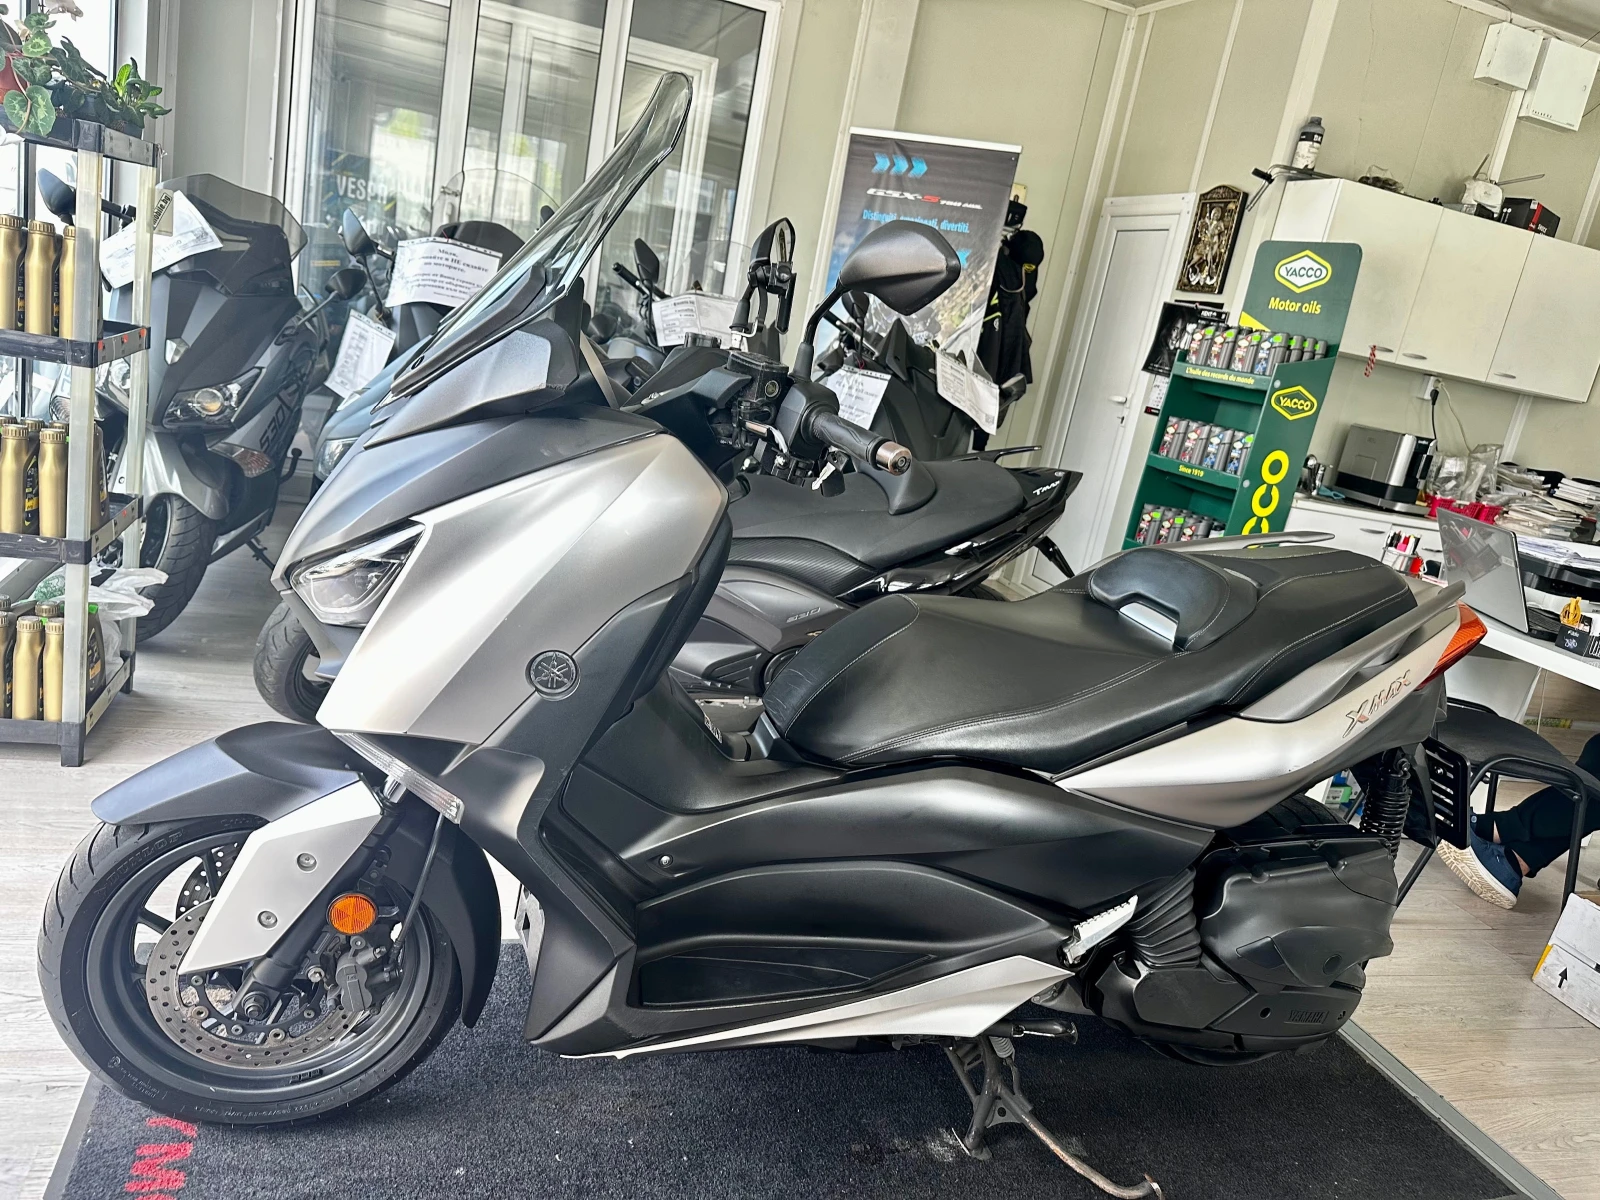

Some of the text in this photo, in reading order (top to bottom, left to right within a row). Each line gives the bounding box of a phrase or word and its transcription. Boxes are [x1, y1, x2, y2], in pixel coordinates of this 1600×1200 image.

[866, 188, 940, 203] GSX-S
[1284, 266, 1323, 279] YACCO
[1268, 297, 1322, 315] Motor oils
[1201, 369, 1211, 378] des
[1210, 372, 1229, 381] records
[1228, 373, 1236, 382] du
[1235, 376, 1255, 385] monde
[1279, 396, 1311, 411] YACCO
[1178, 464, 1205, 478] Since 1919
[1342, 669, 1412, 738] XMAX
[1287, 1009, 1326, 1024] YAMAHA
